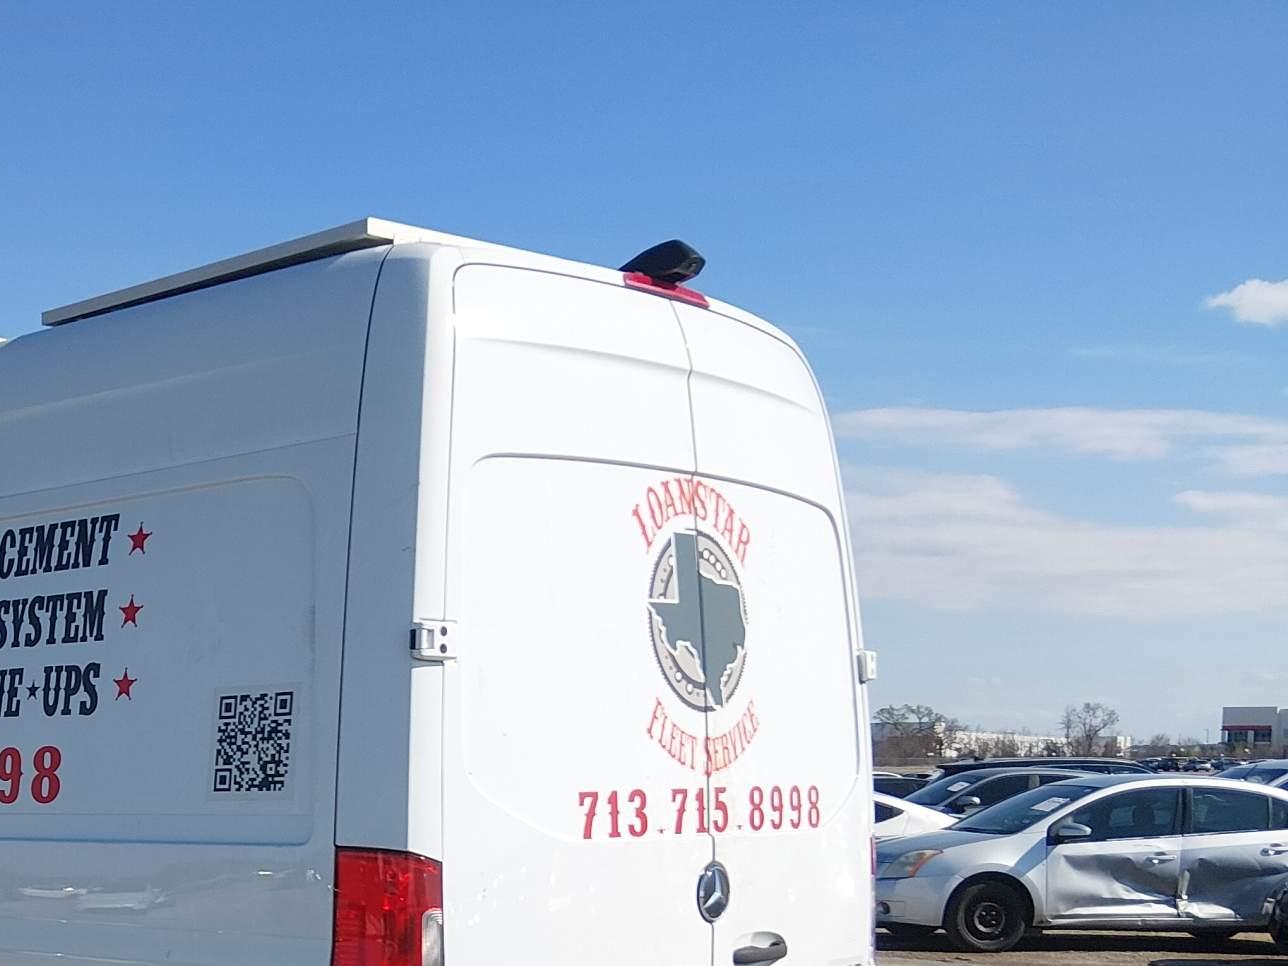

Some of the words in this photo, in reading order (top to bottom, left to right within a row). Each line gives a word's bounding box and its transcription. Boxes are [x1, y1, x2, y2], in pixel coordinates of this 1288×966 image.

[632, 477, 751, 567] LOANSTAR
[646, 697, 697, 772] FLEET
[703, 698, 761, 778] SERVICE
